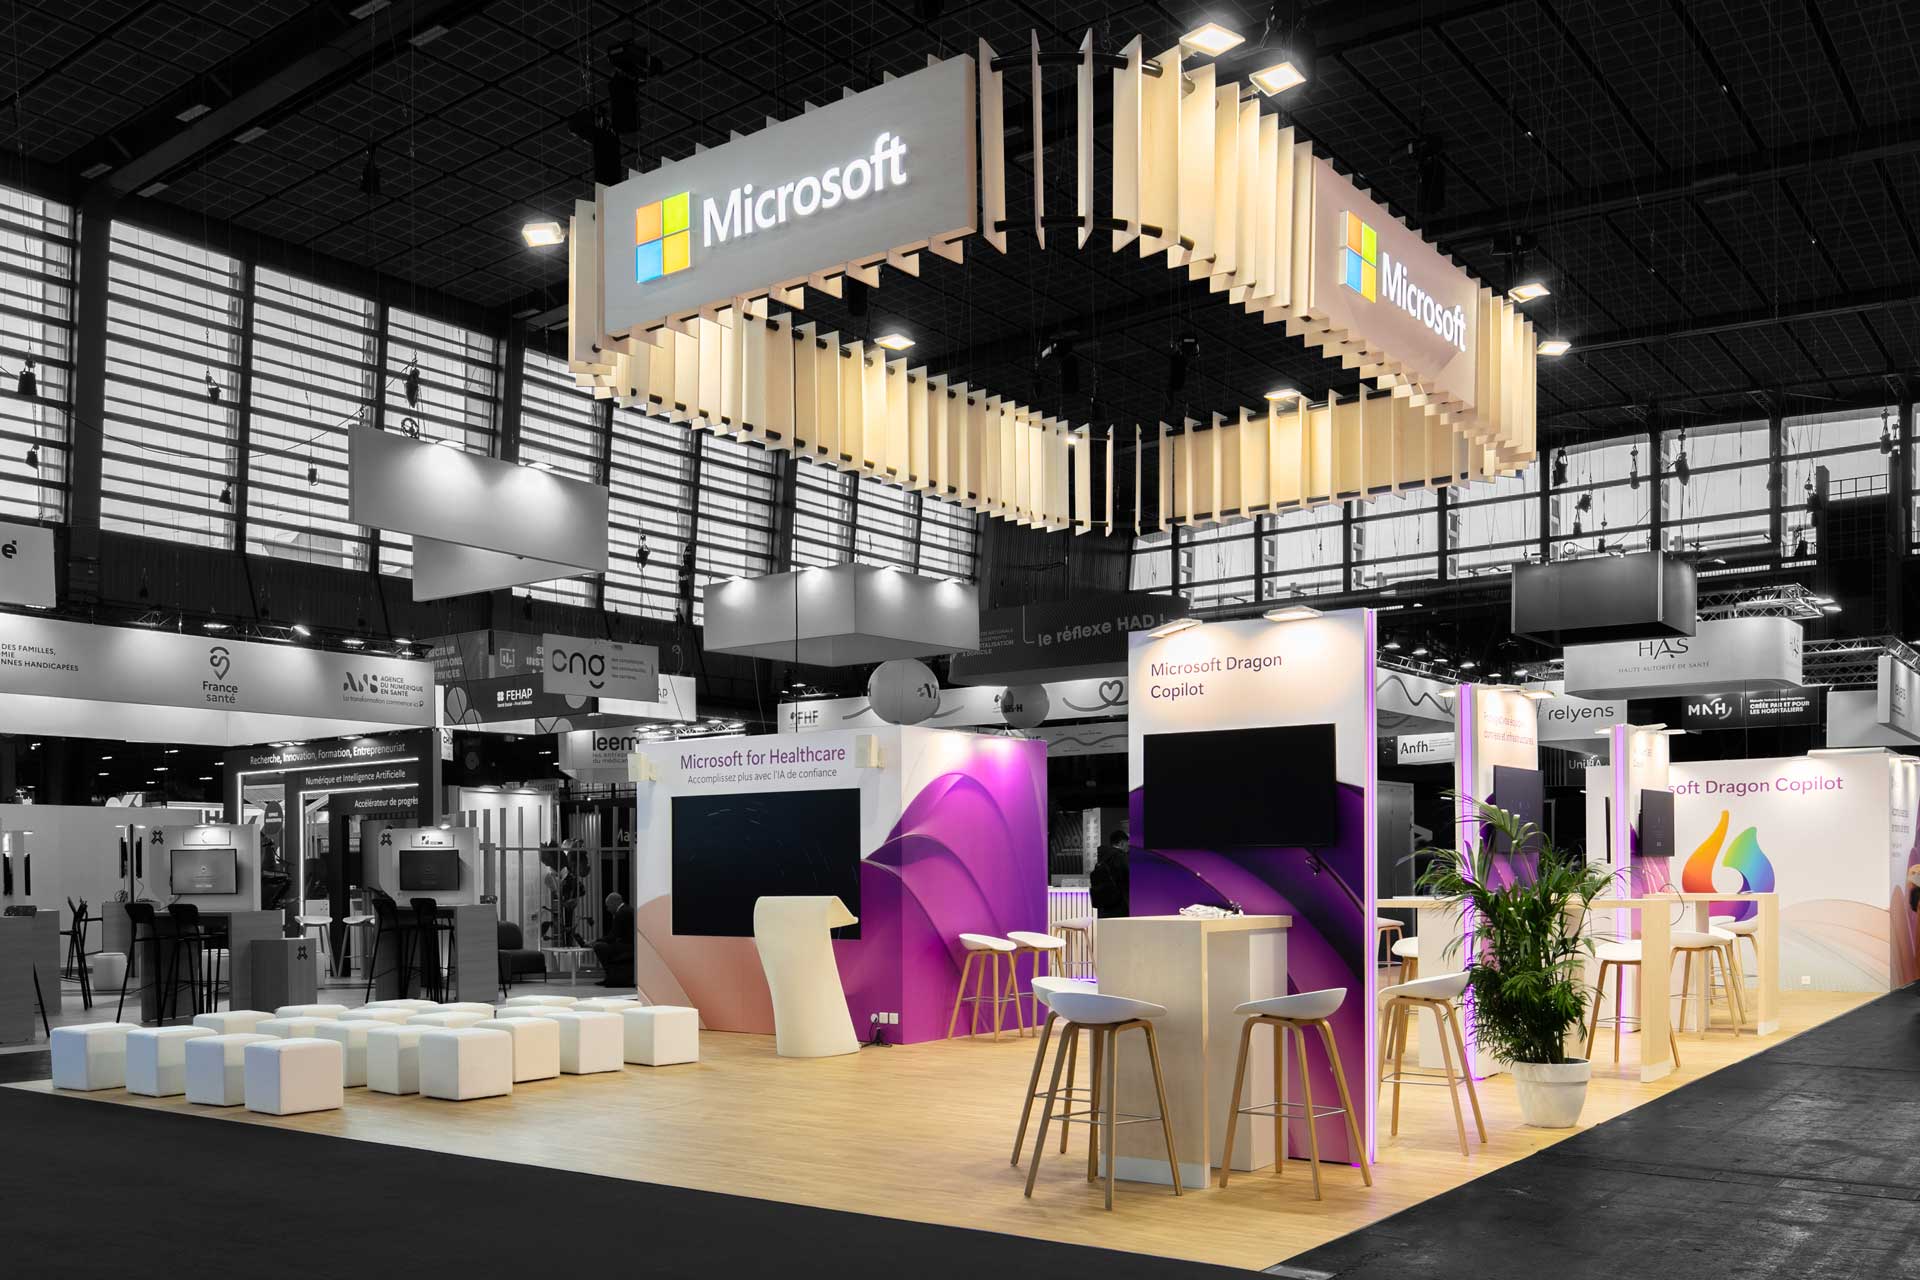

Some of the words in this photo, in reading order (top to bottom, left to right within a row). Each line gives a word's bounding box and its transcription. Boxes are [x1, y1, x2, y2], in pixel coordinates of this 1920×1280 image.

[703, 131, 907, 248] Microsoft
[1382, 251, 1466, 352] Microsoft
[1038, 633, 1052, 647] le
[1057, 621, 1112, 643] réflexe
[1117, 614, 1155, 631] HAD
[1, 643, 16, 651] DES
[18, 644, 56, 656] FAMILLES,
[1638, 637, 1689, 660] HAS
[552, 649, 605, 690] cng
[1151, 657, 1222, 677] Microsoft
[1226, 655, 1282, 672] Dragon
[202, 680, 239, 694] France
[380, 681, 389, 689] DU
[506, 687, 533, 701] FEHAP
[1151, 682, 1205, 701] Copilot
[206, 693, 236, 704] santé
[1770, 701, 1783, 709] PAR
[1791, 700, 1810, 708] POUR
[797, 710, 819, 725] FHF
[1548, 705, 1614, 723] relyens
[592, 730, 640, 751] leem
[1400, 740, 1429, 755] Anfh
[250, 753, 283, 765] Recherche,
[283, 750, 317, 763] Innovation,
[318, 747, 353, 759] Formation,
[353, 742, 406, 757] Entrepreneuriat
[680, 749, 743, 770] Microsoft
[746, 749, 766, 766] for
[769, 746, 846, 765] Healthcare
[305, 775, 335, 786] Numérique
[336, 775, 342, 783] et
[342, 772, 375, 784] Intelligence
[375, 769, 406, 780] Artificielle
[687, 772, 736, 785] Accomplissez
[737, 771, 753, 784] plus
[754, 772, 771, 781] avec
[773, 769, 785, 780] l'IA
[786, 769, 797, 779] de
[798, 767, 837, 779] confiance
[1706, 780, 1770, 797] Dragon
[1775, 776, 1844, 794] Copilot
[354, 799, 389, 808] Accélérateur
[389, 797, 397, 806] de
[397, 795, 418, 807] progrès
